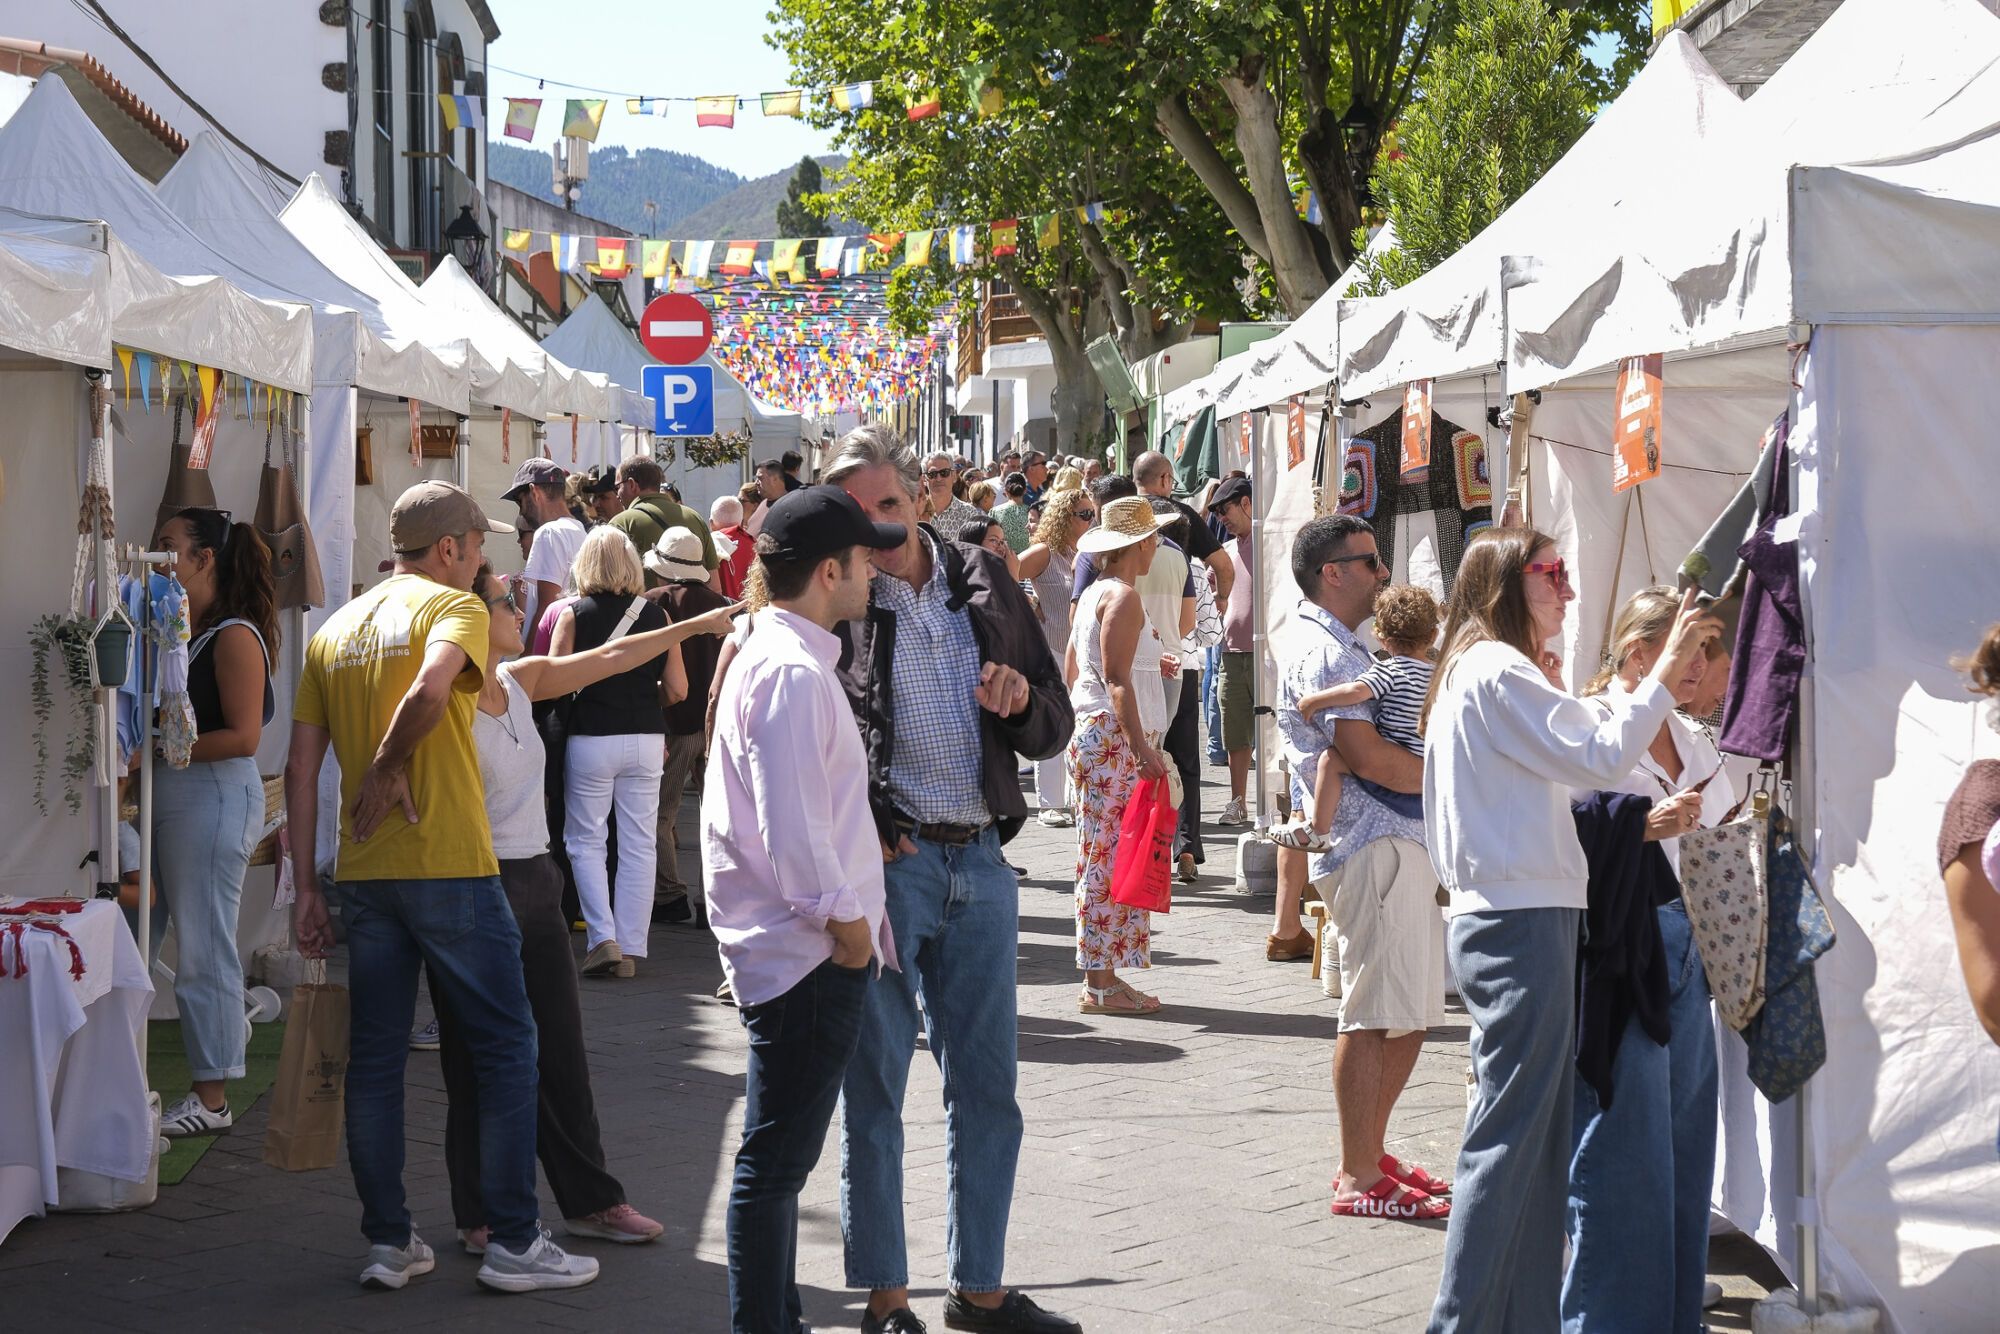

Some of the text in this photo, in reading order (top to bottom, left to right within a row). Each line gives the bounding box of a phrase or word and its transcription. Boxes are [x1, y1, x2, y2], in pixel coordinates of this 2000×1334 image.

[663, 374, 697, 420] P
[347, 657, 368, 668] STOP
[1353, 1199, 1417, 1217] HUGO
